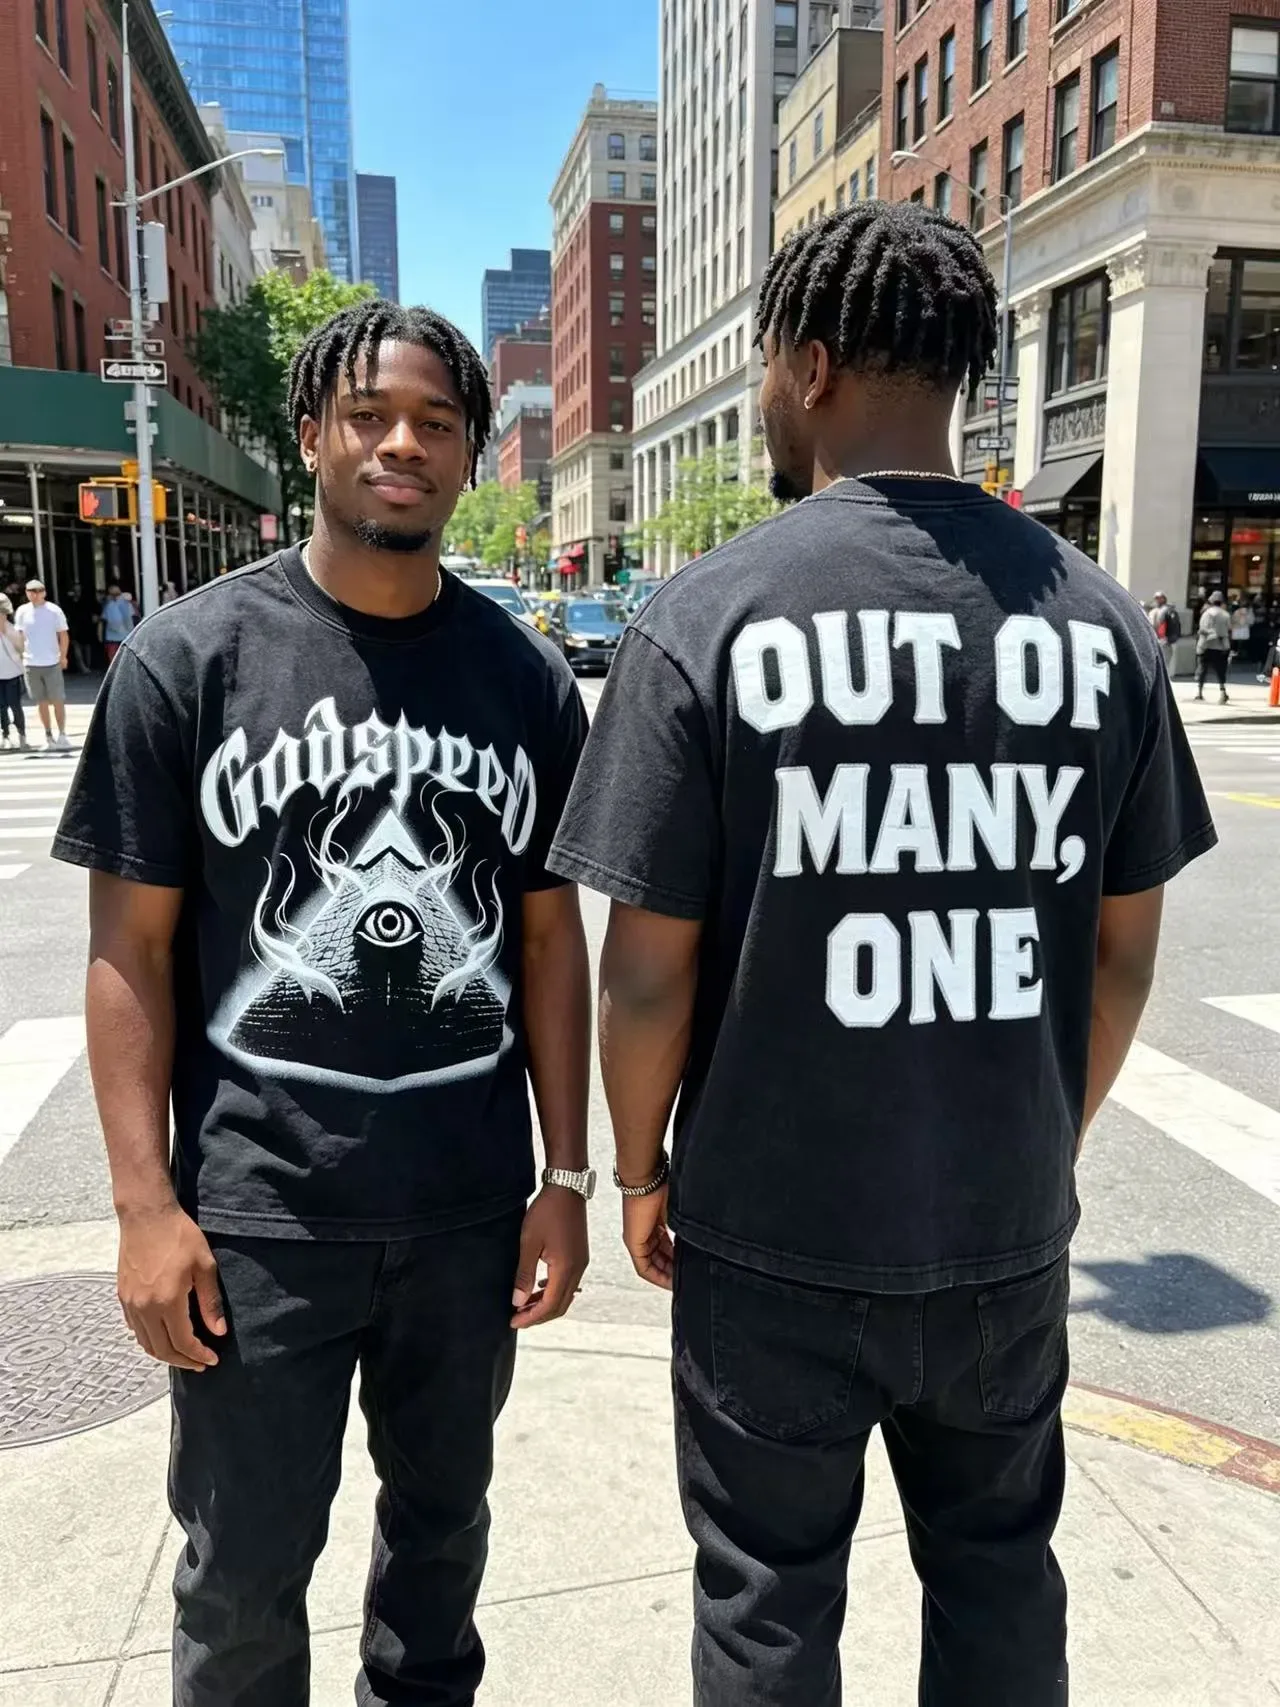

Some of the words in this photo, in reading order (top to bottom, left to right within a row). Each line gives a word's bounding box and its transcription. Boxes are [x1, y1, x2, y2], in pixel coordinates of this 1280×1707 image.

[730, 609, 962, 734] OUT
[994, 614, 1118, 730] OF
[773, 763, 1086, 884] MANY,
[825, 907, 1043, 1028] ONE
